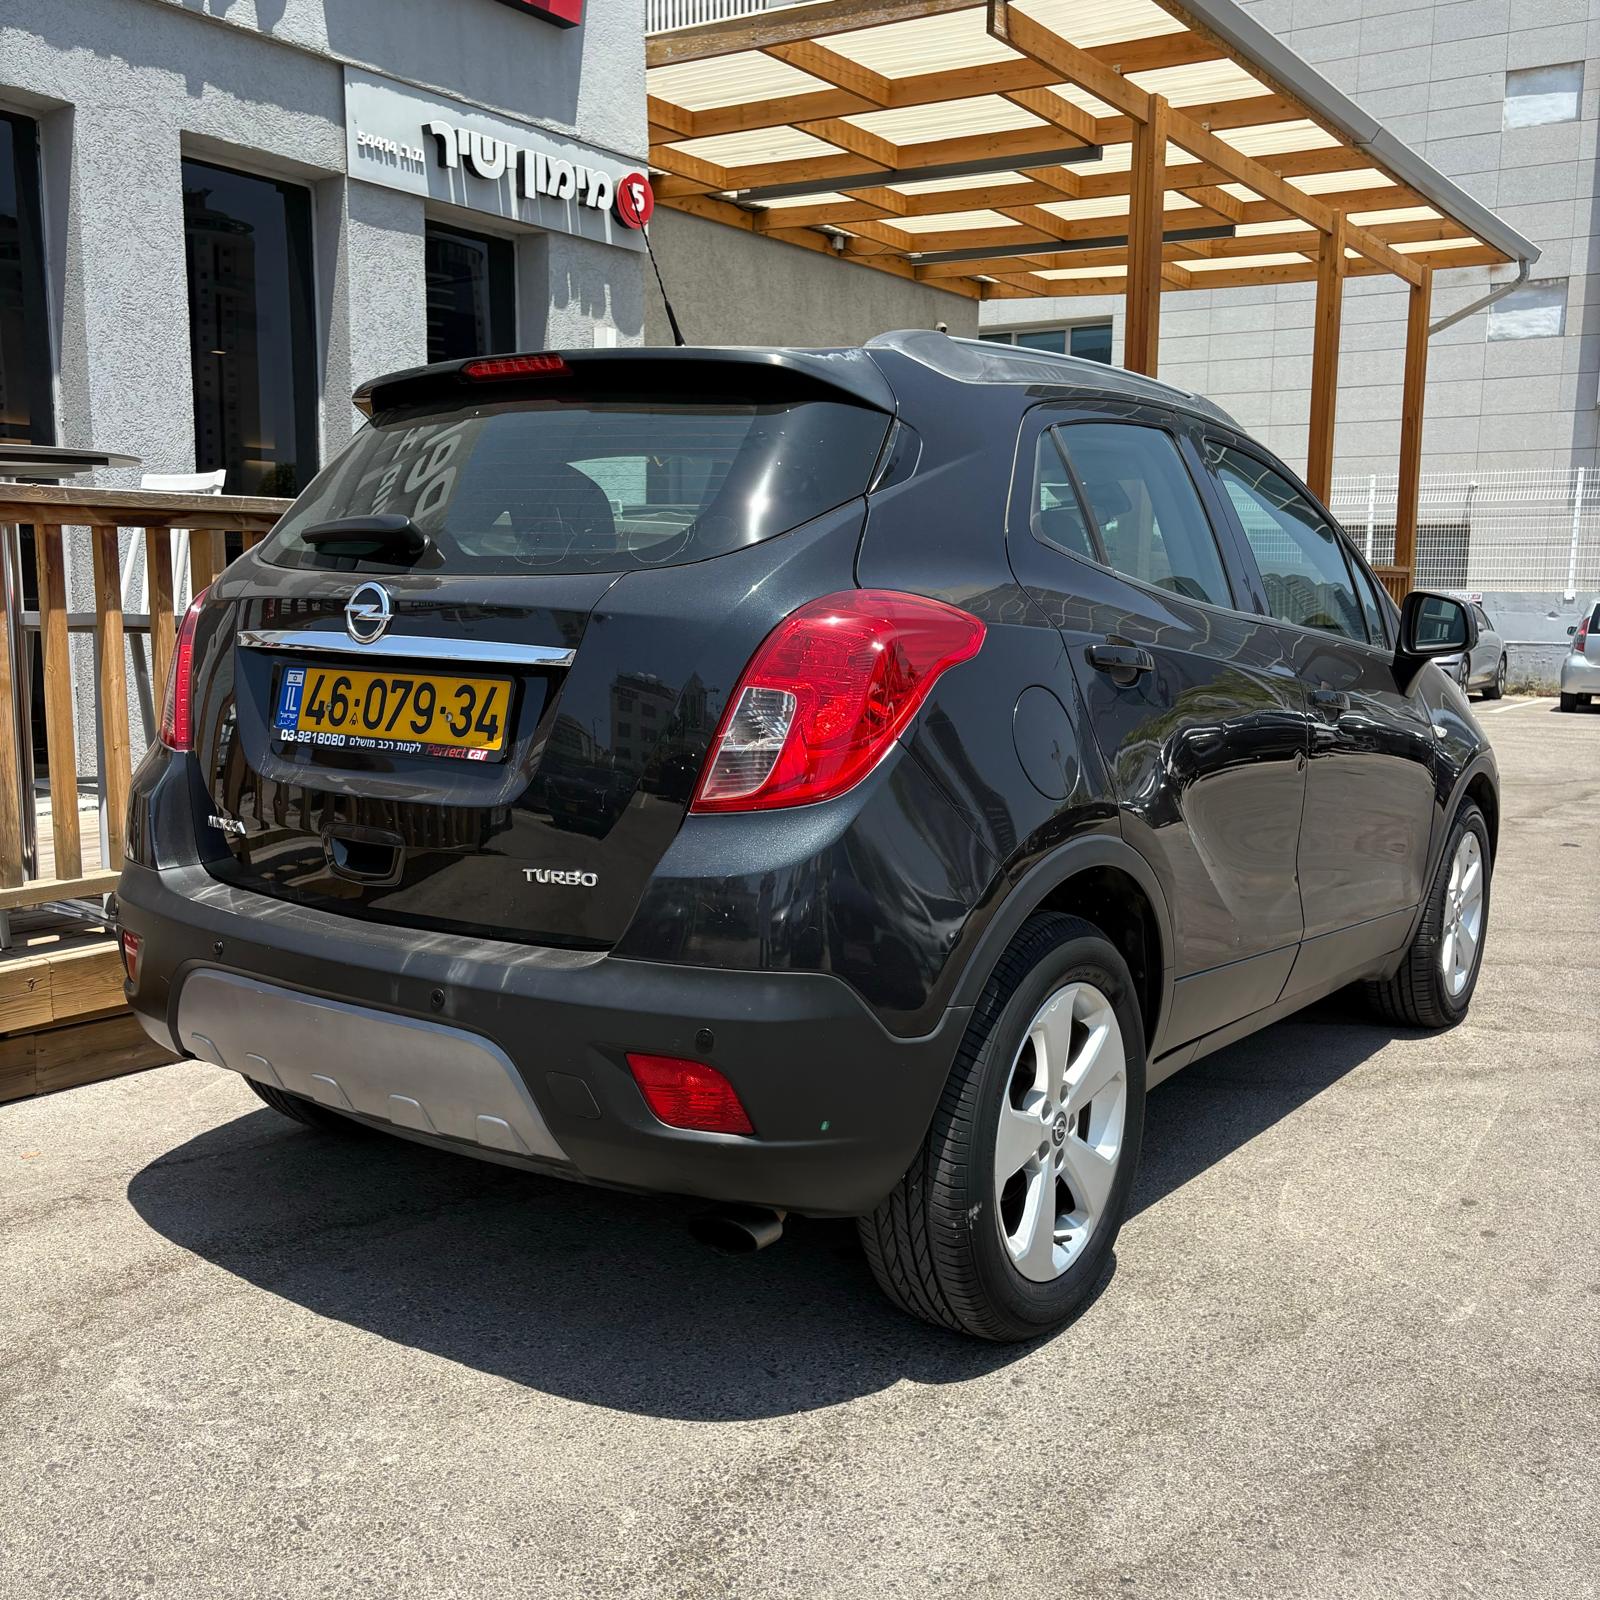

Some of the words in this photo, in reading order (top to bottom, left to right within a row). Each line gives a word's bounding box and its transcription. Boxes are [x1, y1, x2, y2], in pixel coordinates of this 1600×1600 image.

[357, 130, 397, 155] 54414
[424, 120, 517, 180] ישיר
[522, 149, 613, 211] מימון
[630, 182, 646, 213] 5
[285, 687, 297, 711] IL
[349, 736, 376, 748] מושלם
[377, 740, 394, 750] רכב
[396, 741, 421, 754] לקנות
[425, 744, 468, 760] Perfect
[467, 749, 488, 761] car
[521, 868, 599, 887] TURBO
